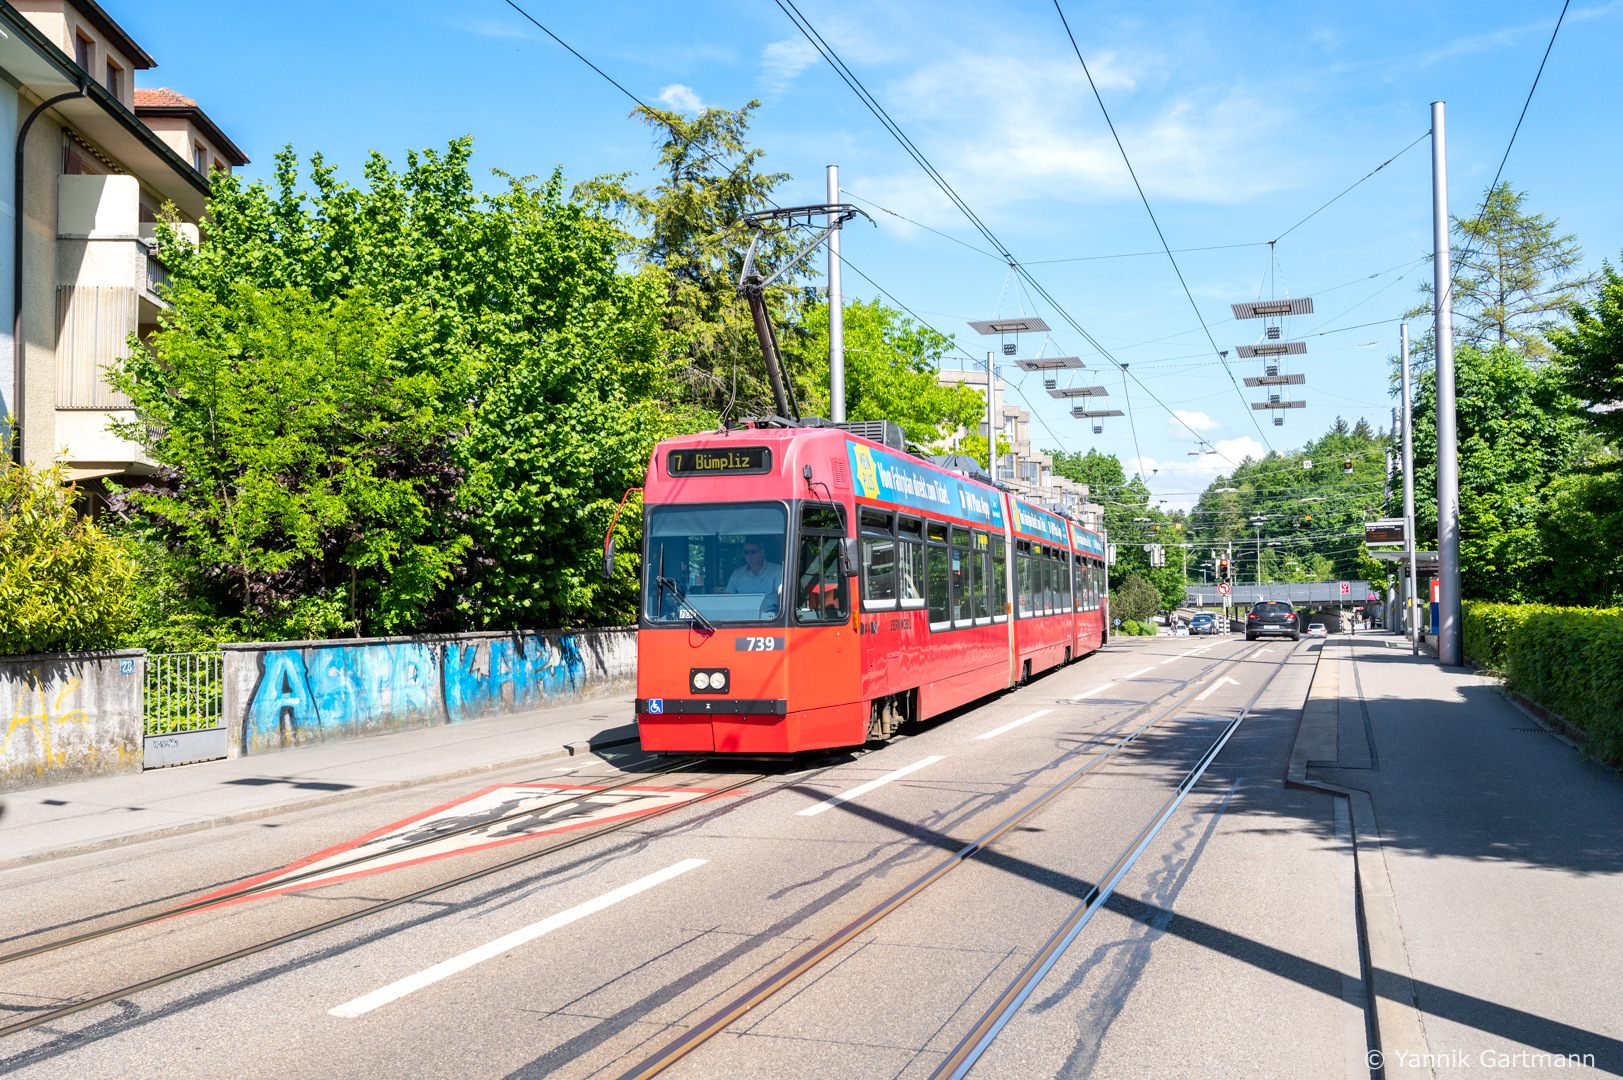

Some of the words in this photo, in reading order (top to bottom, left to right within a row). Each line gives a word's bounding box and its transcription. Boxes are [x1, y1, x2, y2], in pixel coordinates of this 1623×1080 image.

[674, 455, 682, 470] 7
[695, 452, 750, 470] Bümpliz
[746, 636, 775, 651] 739
[122, 660, 133, 673] 28
